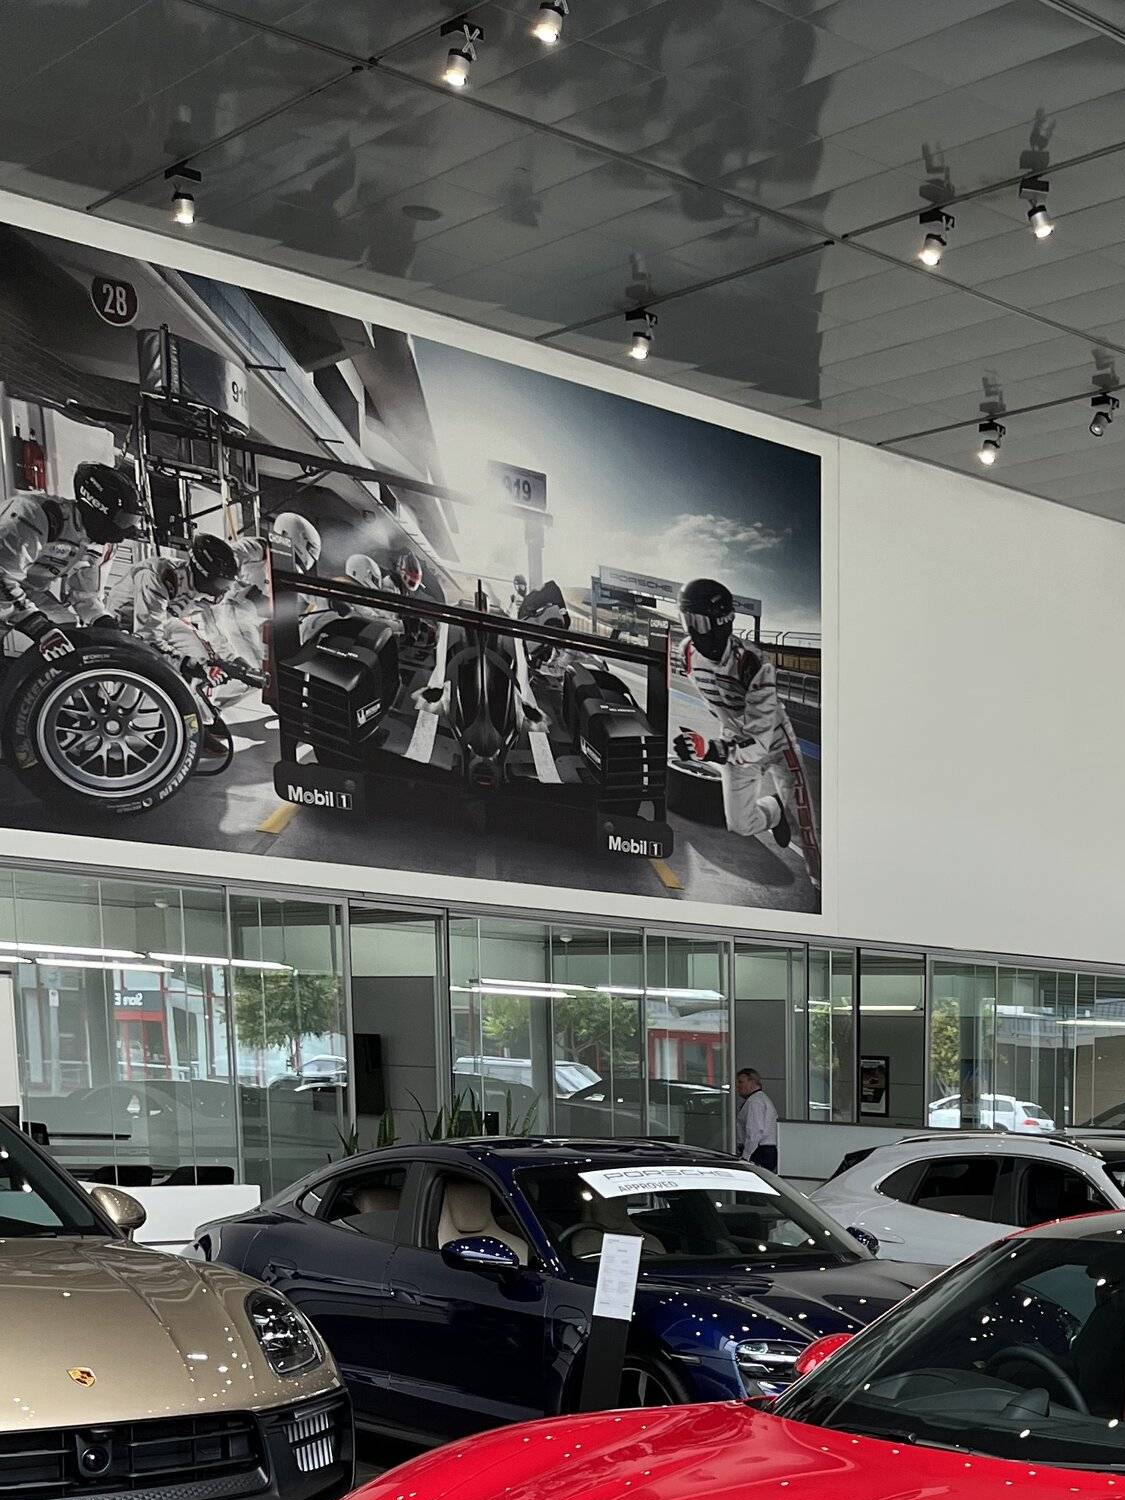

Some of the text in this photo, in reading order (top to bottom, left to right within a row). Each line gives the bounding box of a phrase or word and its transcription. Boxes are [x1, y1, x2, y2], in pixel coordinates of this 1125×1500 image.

[102, 283, 128, 316] 28
[159, 740, 197, 800] MICHELIN
[287, 784, 335, 808] Mobil
[608, 835, 647, 855] Mobil
[603, 1169, 735, 1180] PORSCHE
[617, 1181, 679, 1193] APPROVED
